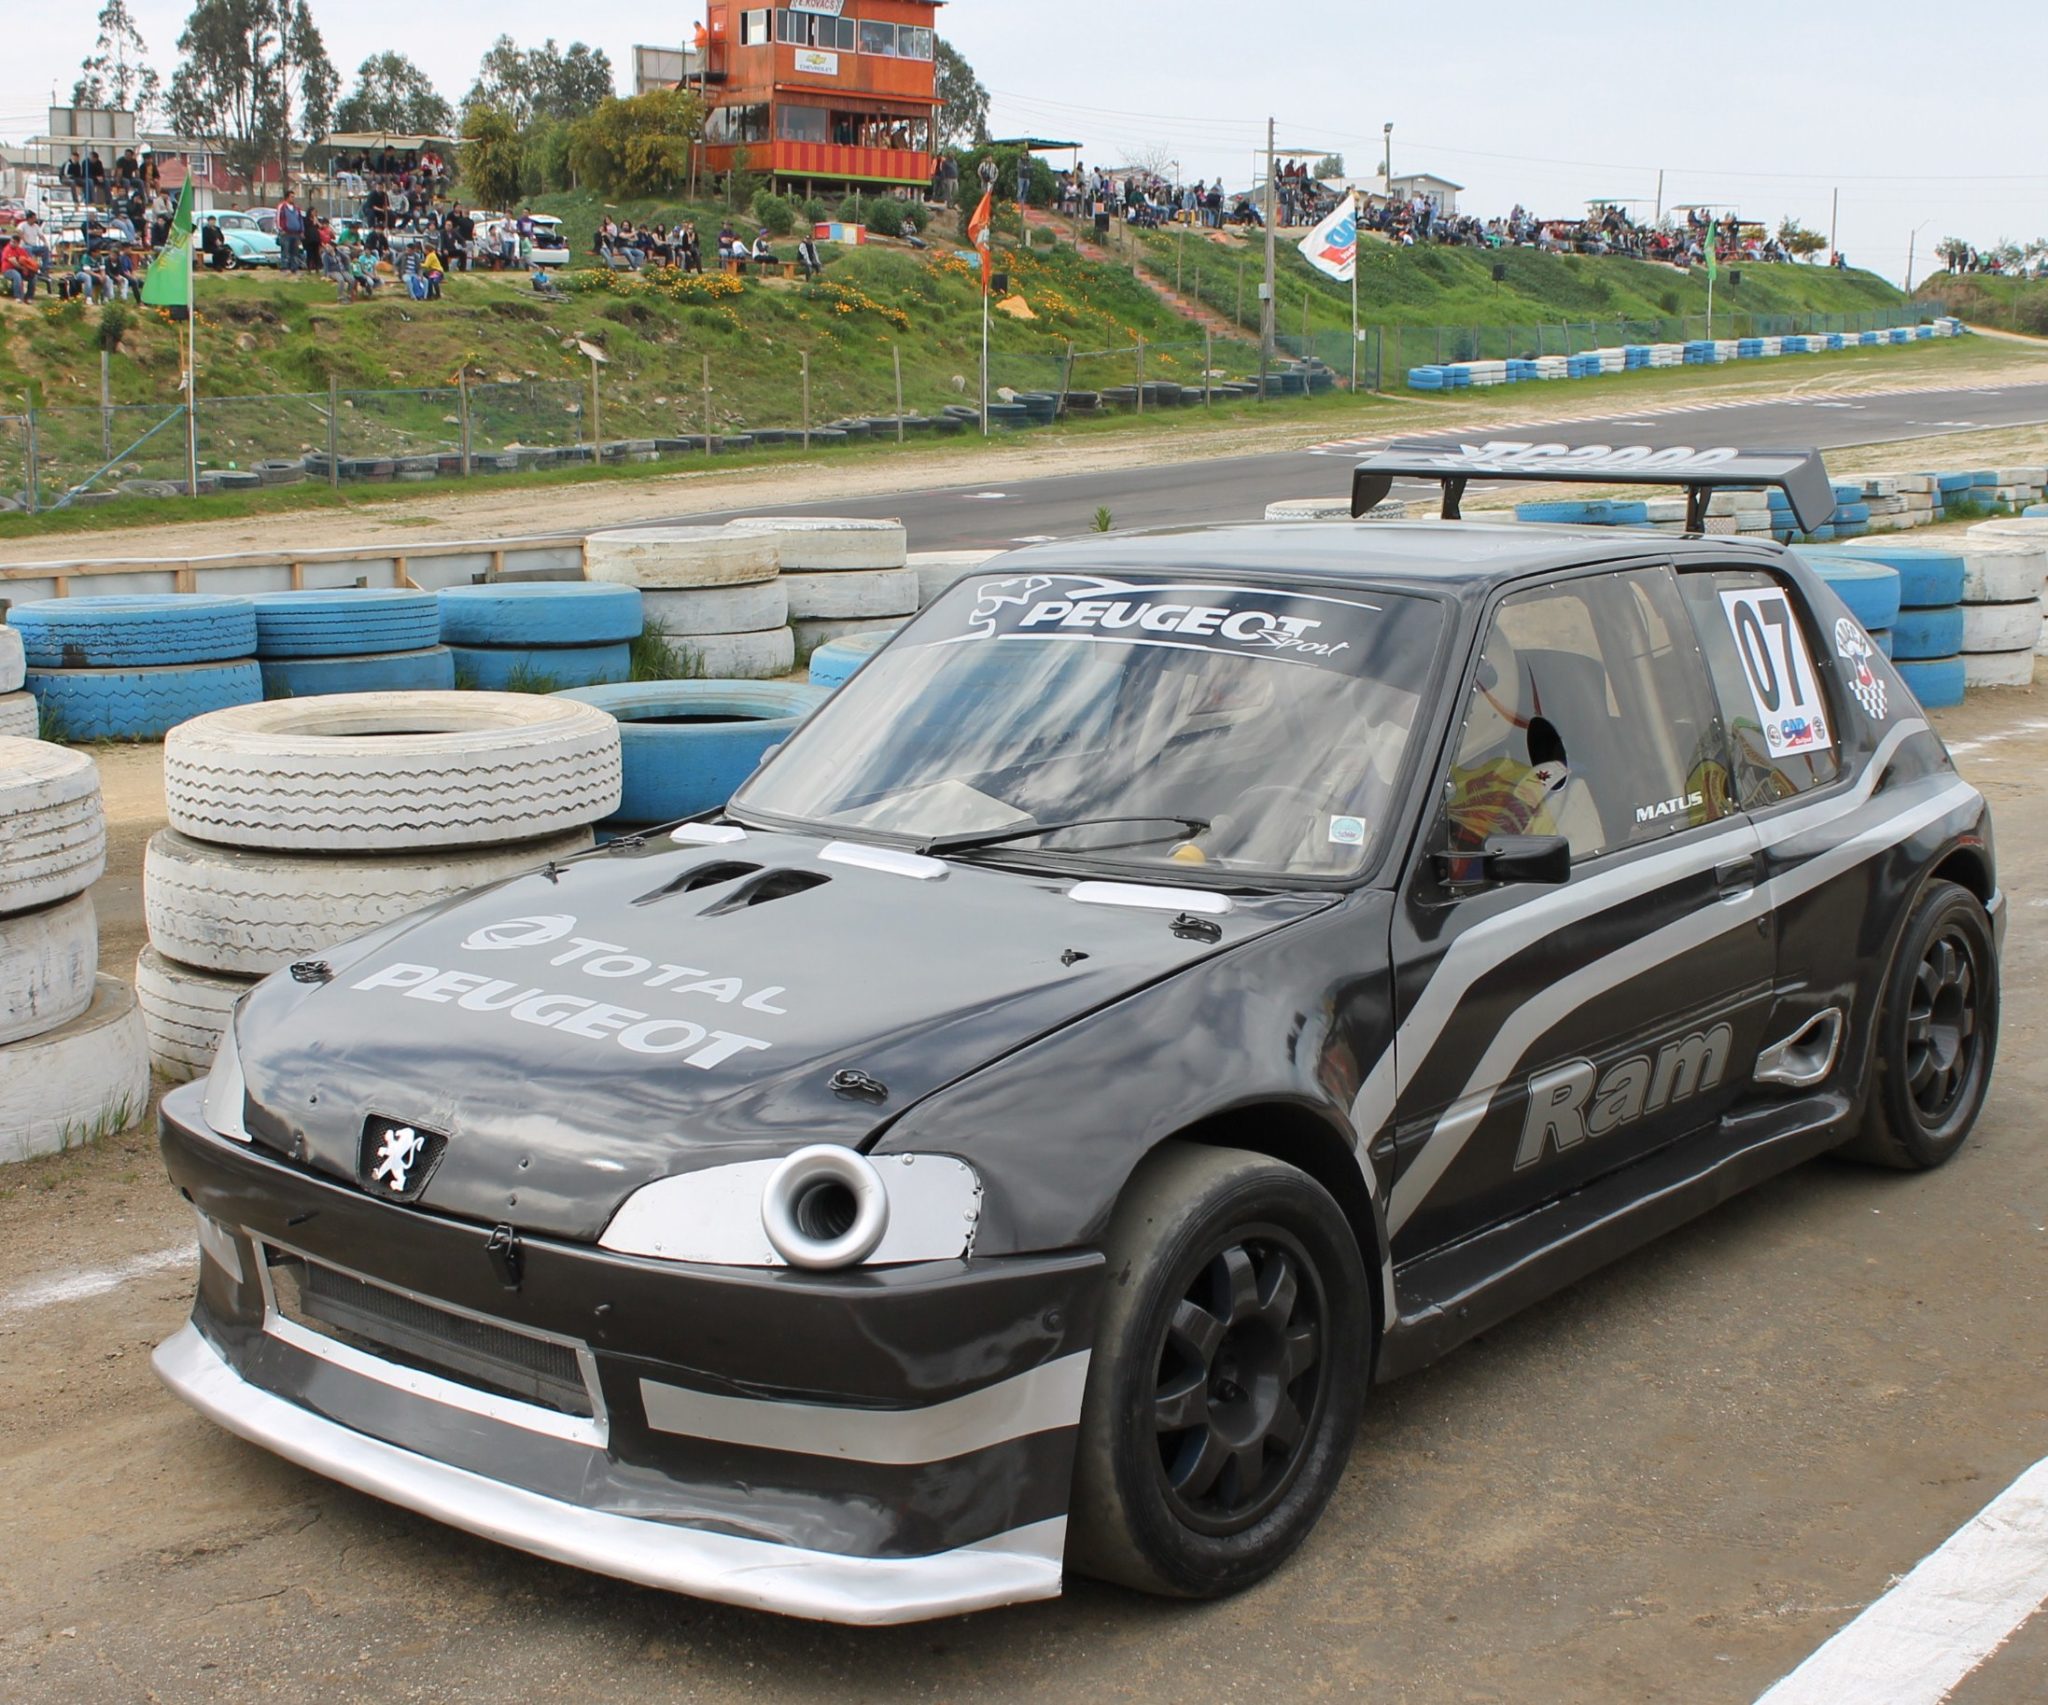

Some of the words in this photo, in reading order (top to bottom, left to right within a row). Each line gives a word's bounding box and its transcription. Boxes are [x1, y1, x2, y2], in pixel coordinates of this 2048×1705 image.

[1476, 441, 1739, 468] TC2000
[1018, 601, 1321, 641] PEUGEOT
[1241, 628, 1350, 658] Sport
[1733, 597, 1804, 713] 07
[1636, 790, 1703, 823] MATUS
[549, 936, 788, 1015] TOTAL
[350, 962, 773, 1071] PEUGEOT
[1513, 1021, 1733, 1172] Ram
